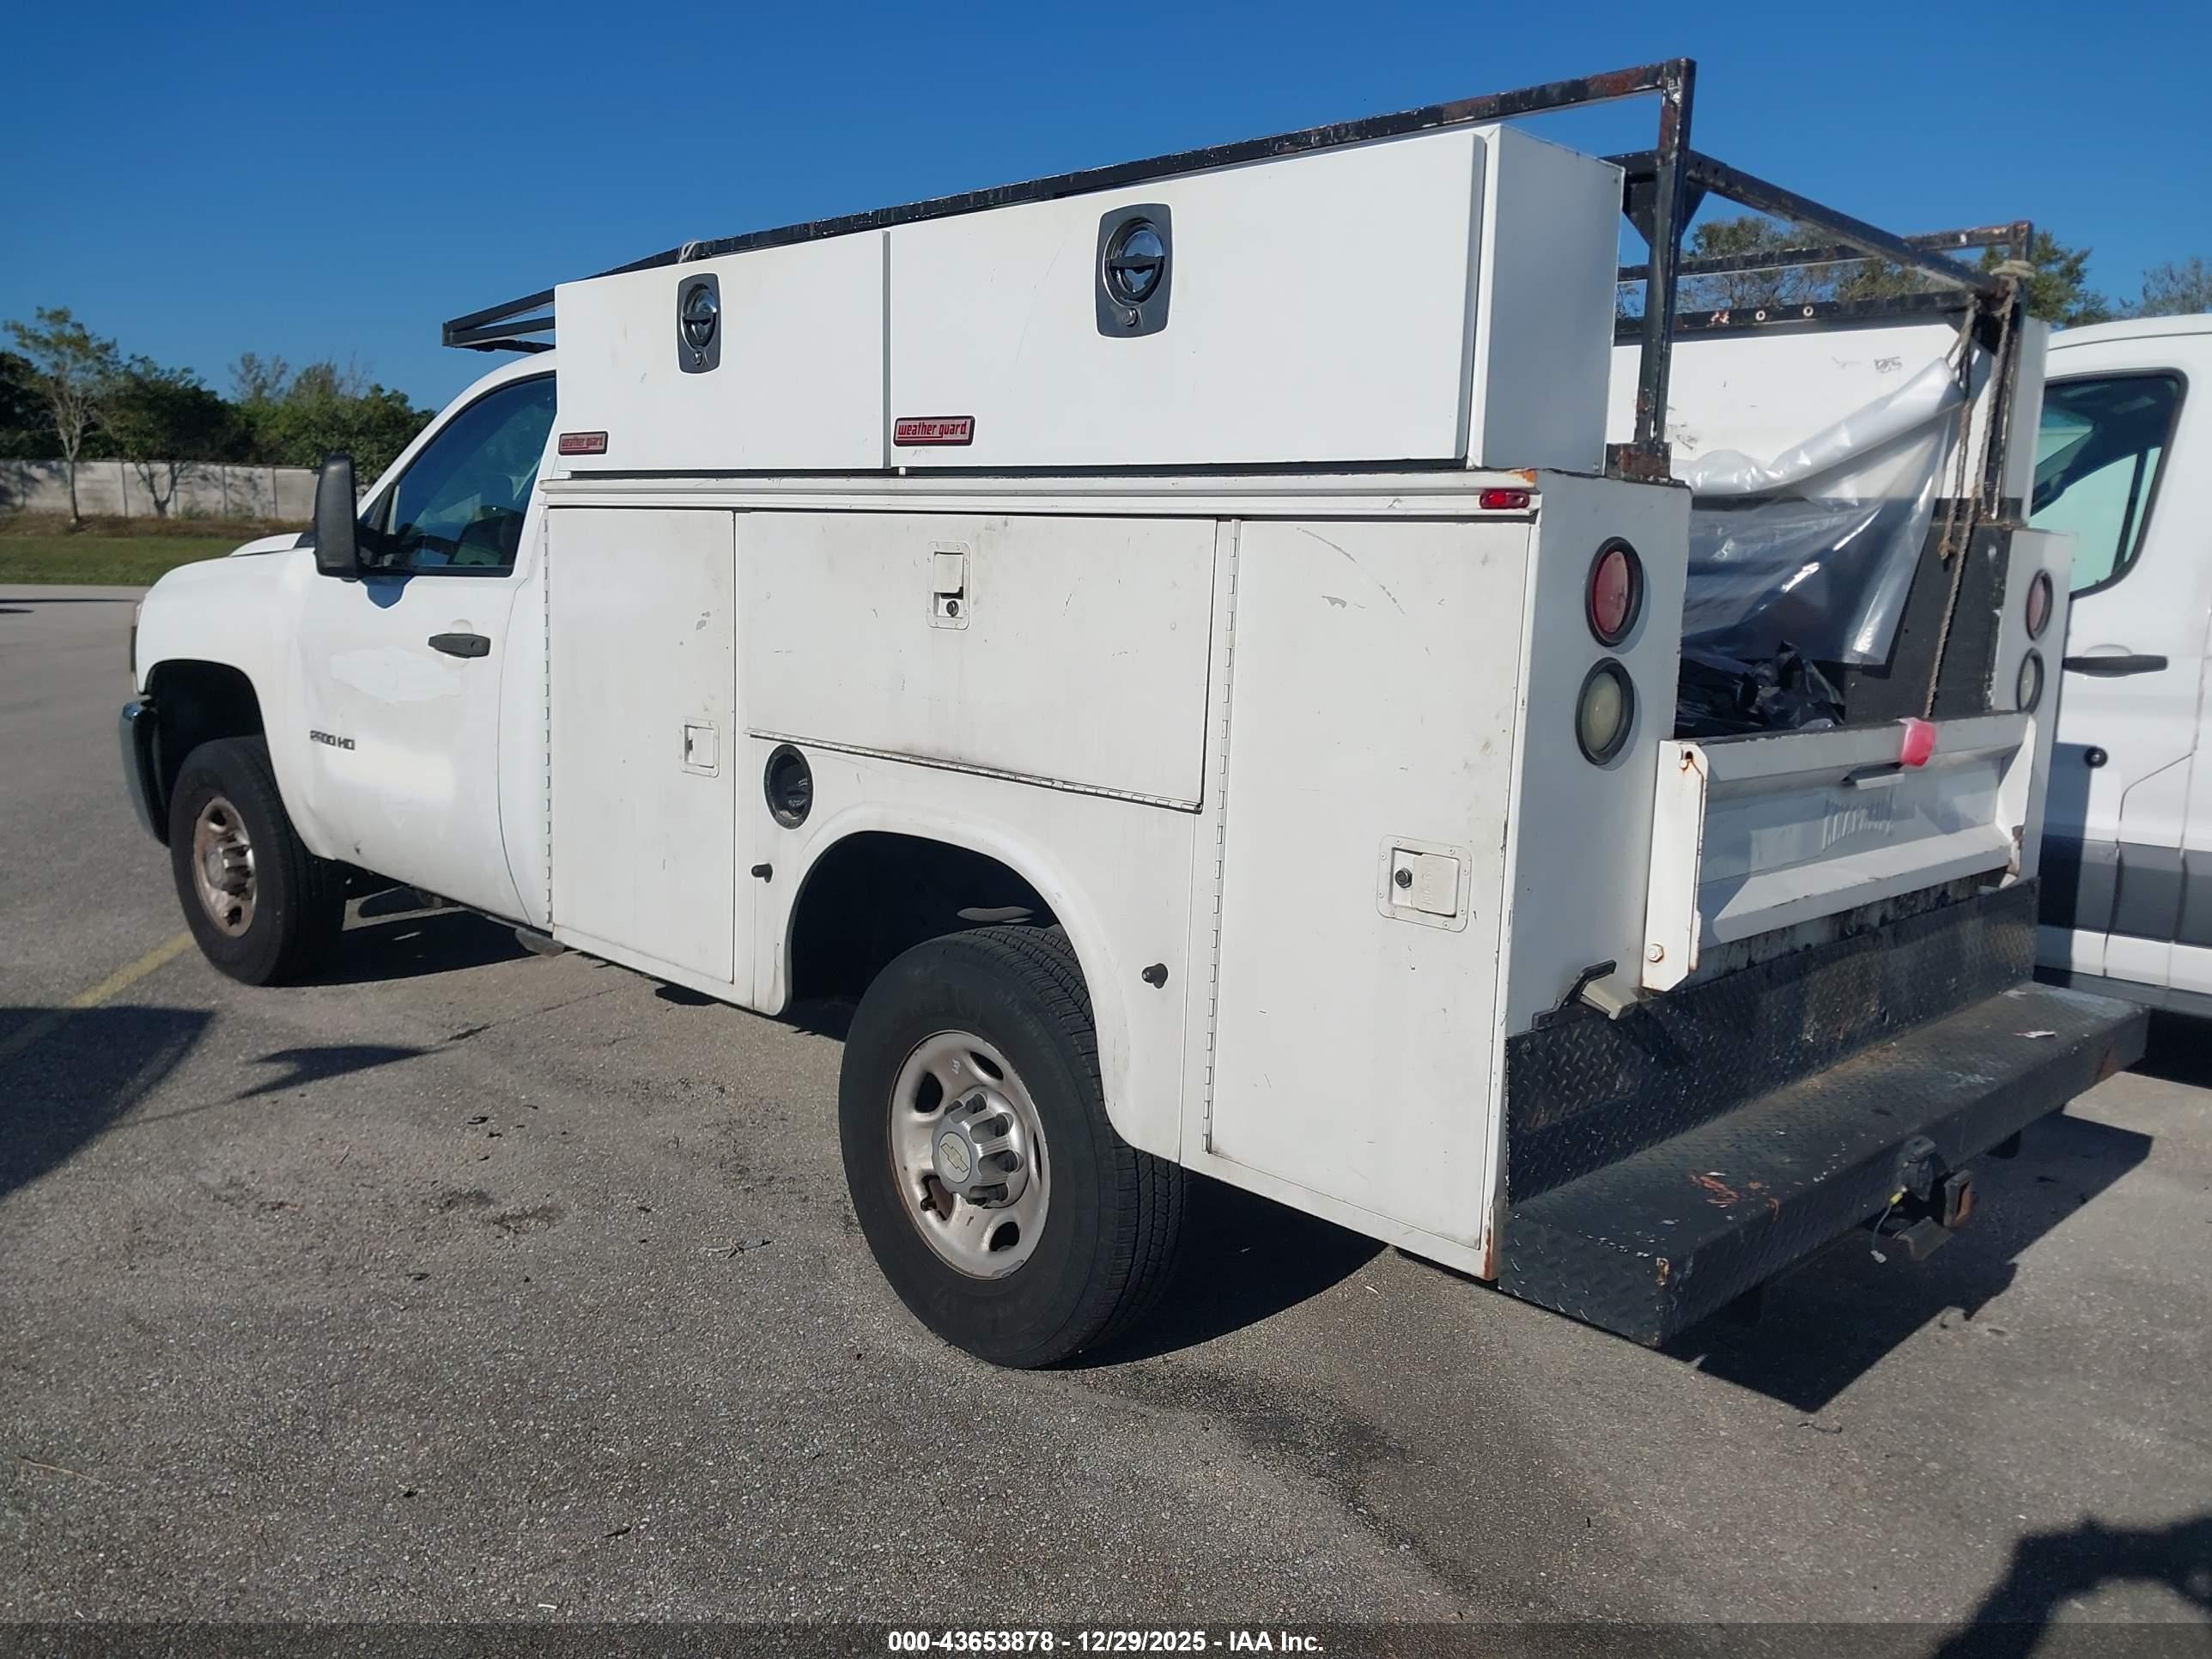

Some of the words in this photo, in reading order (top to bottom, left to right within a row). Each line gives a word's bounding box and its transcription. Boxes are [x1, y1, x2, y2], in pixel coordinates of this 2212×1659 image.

[898, 422, 938, 436] weather
[938, 420, 968, 439] guard
[337, 737, 356, 750] HD
